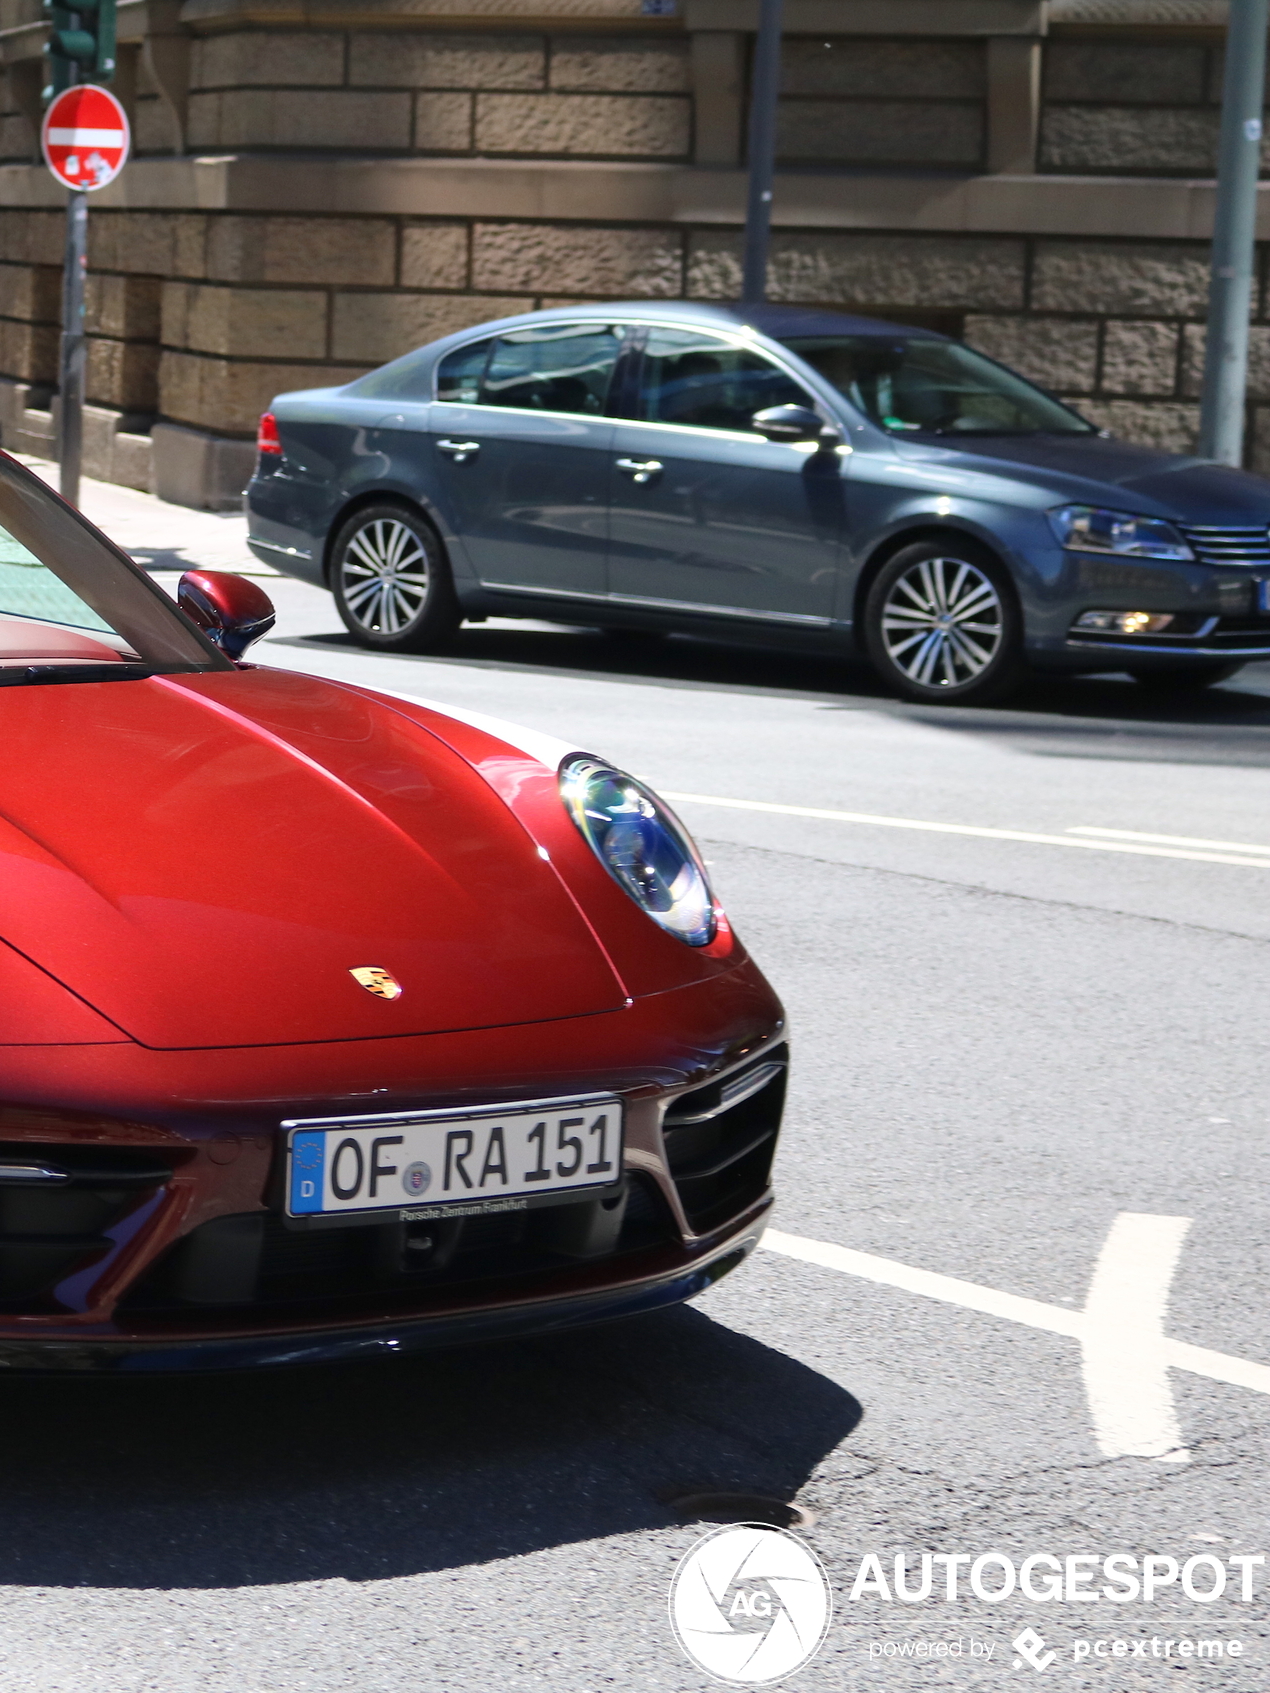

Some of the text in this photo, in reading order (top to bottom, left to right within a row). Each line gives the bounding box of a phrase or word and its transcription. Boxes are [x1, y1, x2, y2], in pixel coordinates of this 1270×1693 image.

[331, 1114, 612, 1200] OF RA 151
[301, 1180, 315, 1197] D
[400, 1200, 528, 1221] Porsche Zentrum Frankfurt
